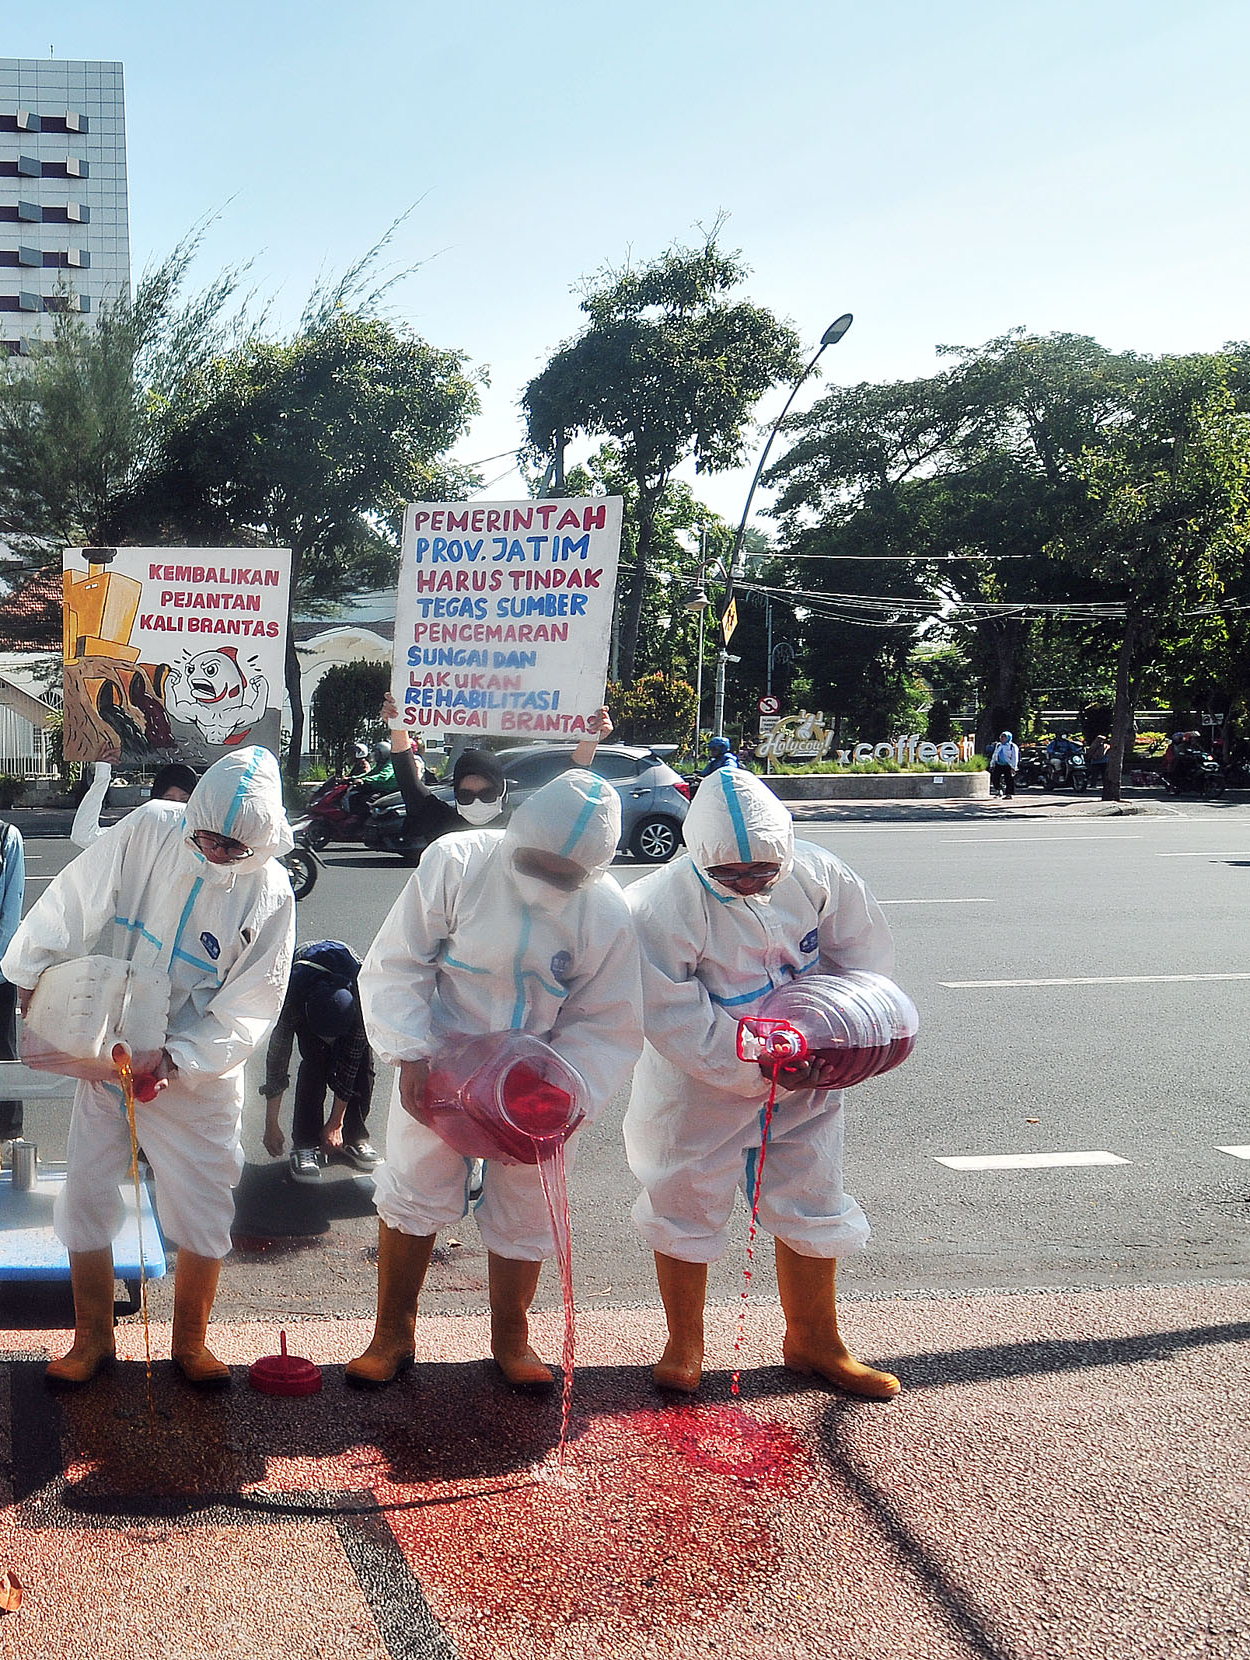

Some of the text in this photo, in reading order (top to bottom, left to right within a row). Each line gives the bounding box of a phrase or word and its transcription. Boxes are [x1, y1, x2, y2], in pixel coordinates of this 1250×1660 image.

[416, 505, 606, 532] PEMERINTAH
[416, 534, 590, 563] PROV. JATIM
[150, 564, 279, 586] KEMBALIKAN
[418, 569, 602, 592] HARUS TINDAK
[161, 591, 260, 611] PEJANTAN
[417, 593, 588, 620] TEGAS SUMBER
[141, 614, 278, 637] KALI BRANTAS
[415, 623, 568, 643] PENCEMARAN
[407, 646, 536, 669] SUNGAI DAN
[405, 688, 559, 711] REHABILITASI
[403, 706, 489, 728] SUNGAI
[759, 729, 835, 757] Holycow!
[853, 734, 960, 764] coffee
